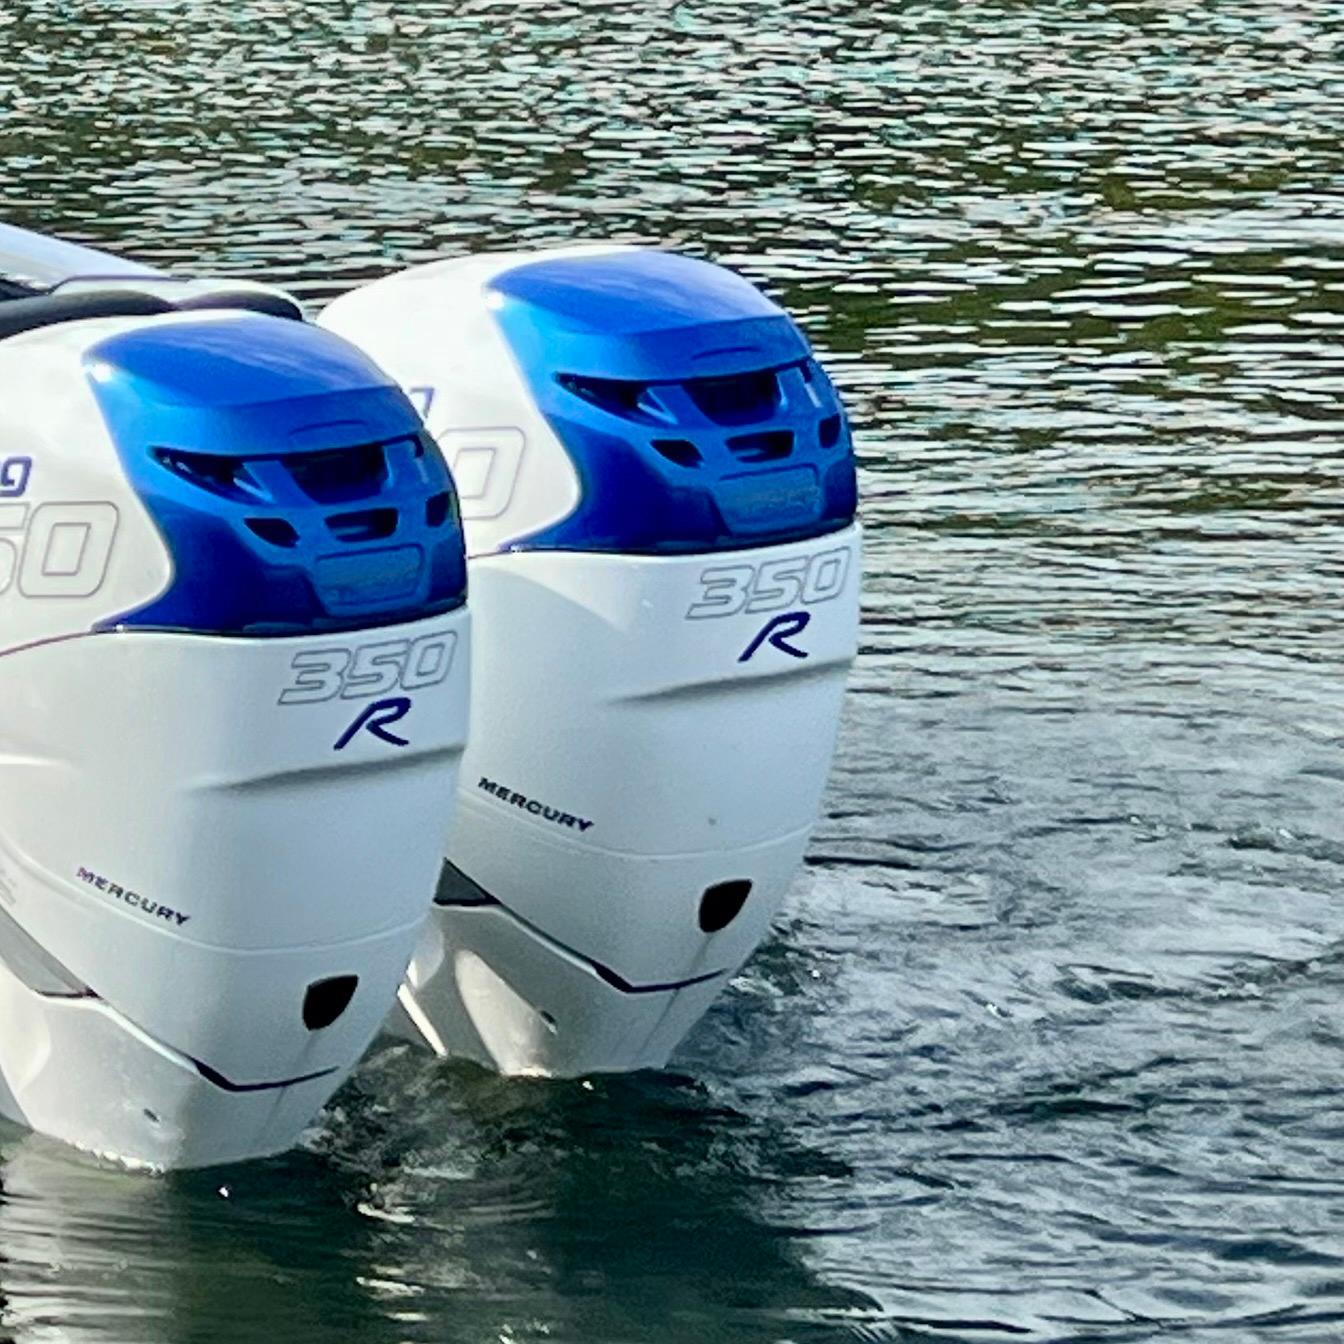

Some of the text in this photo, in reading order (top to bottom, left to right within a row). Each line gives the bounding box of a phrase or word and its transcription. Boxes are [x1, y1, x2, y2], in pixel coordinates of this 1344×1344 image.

[685, 546, 853, 620] 350
[737, 611, 811, 663] R
[277, 630, 459, 706] 350
[333, 696, 412, 751] R
[477, 776, 595, 833] MERCURY
[76, 866, 192, 926] MERCURY
